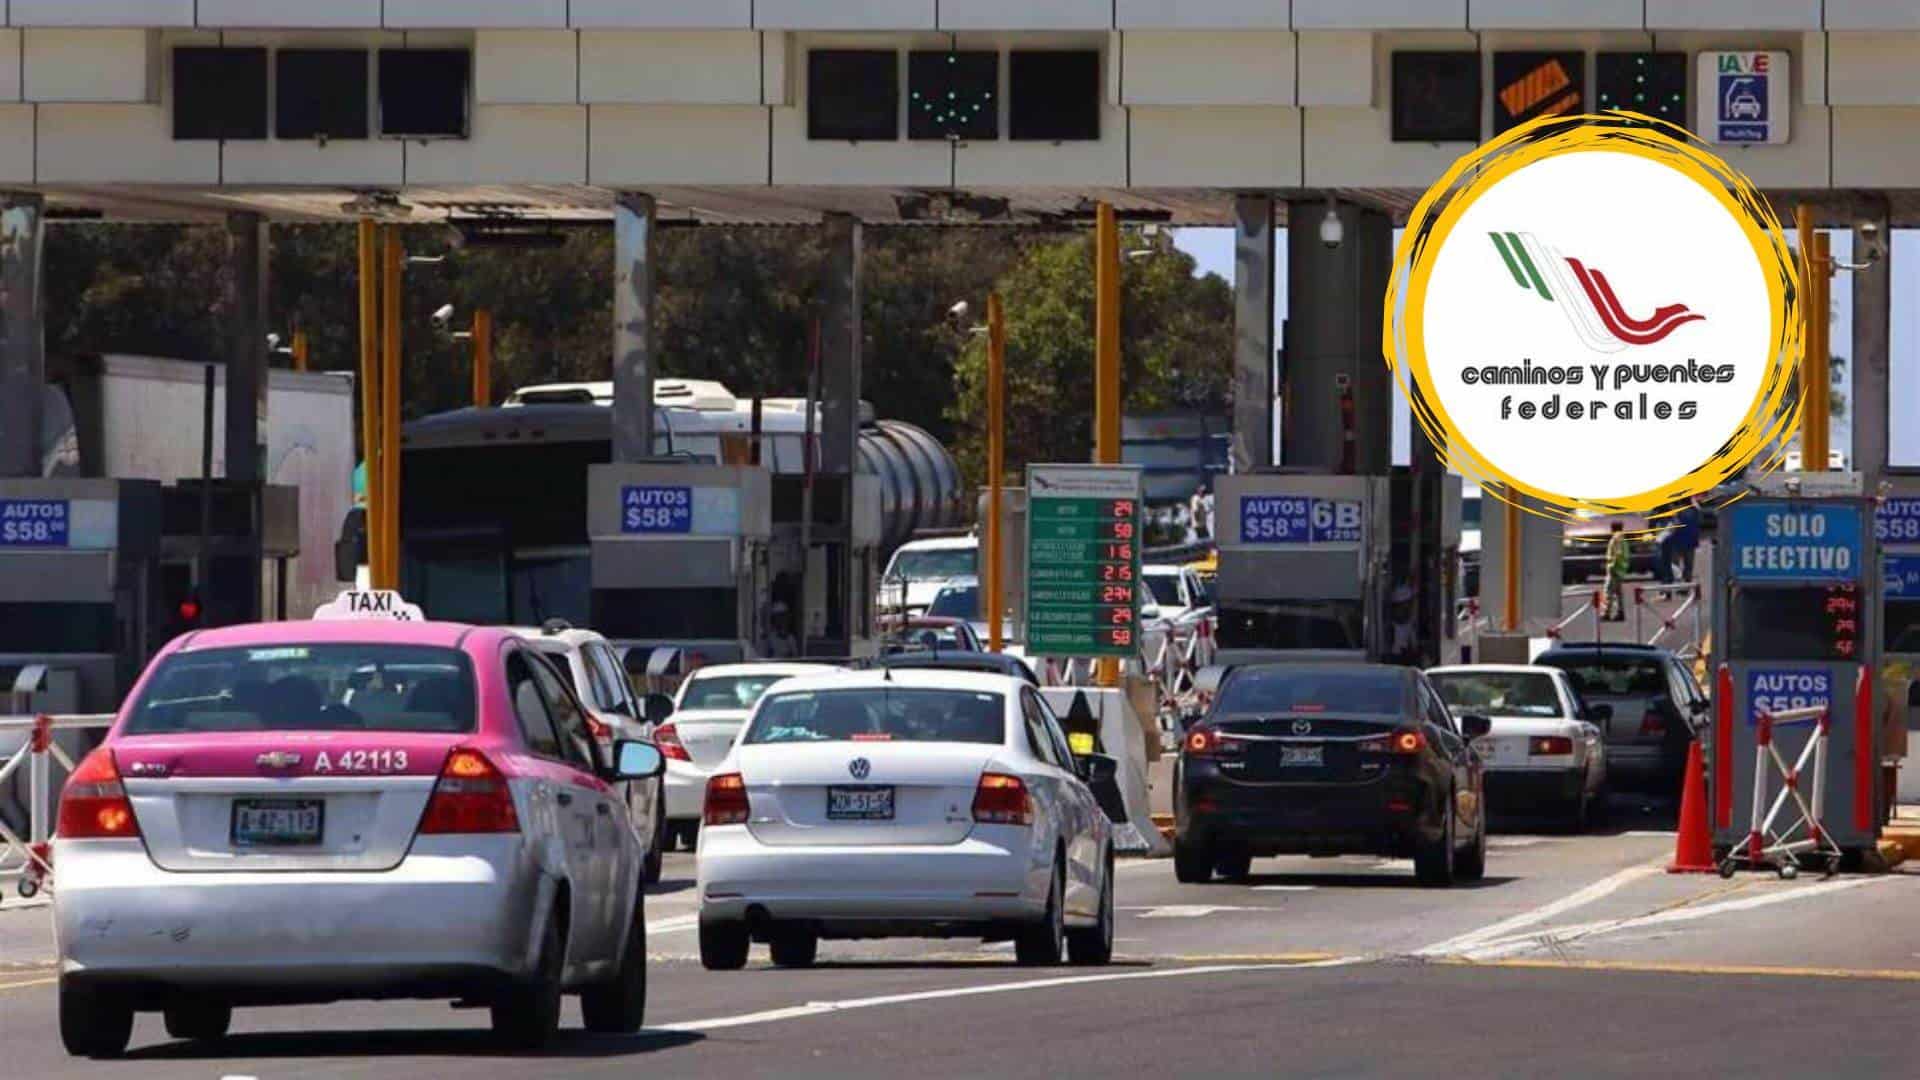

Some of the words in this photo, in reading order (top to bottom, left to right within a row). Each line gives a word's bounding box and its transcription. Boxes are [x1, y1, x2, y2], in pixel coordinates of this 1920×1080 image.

[627, 490, 688, 505] AUTOS
[3, 504, 64, 518] AUTOS
[1114, 502, 1132, 517] 29
[1246, 501, 1305, 515] AUTOS
[1313, 502, 1360, 528] 6B
[1114, 523, 1132, 538] 58
[1766, 513, 1826, 537] SOLO
[1740, 546, 1850, 570] EFECTIVO
[347, 592, 392, 612] TAXI
[1112, 608, 1131, 623] 29
[1754, 674, 1828, 692] AUTOS
[314, 752, 333, 770] A
[340, 750, 408, 769] 42113
